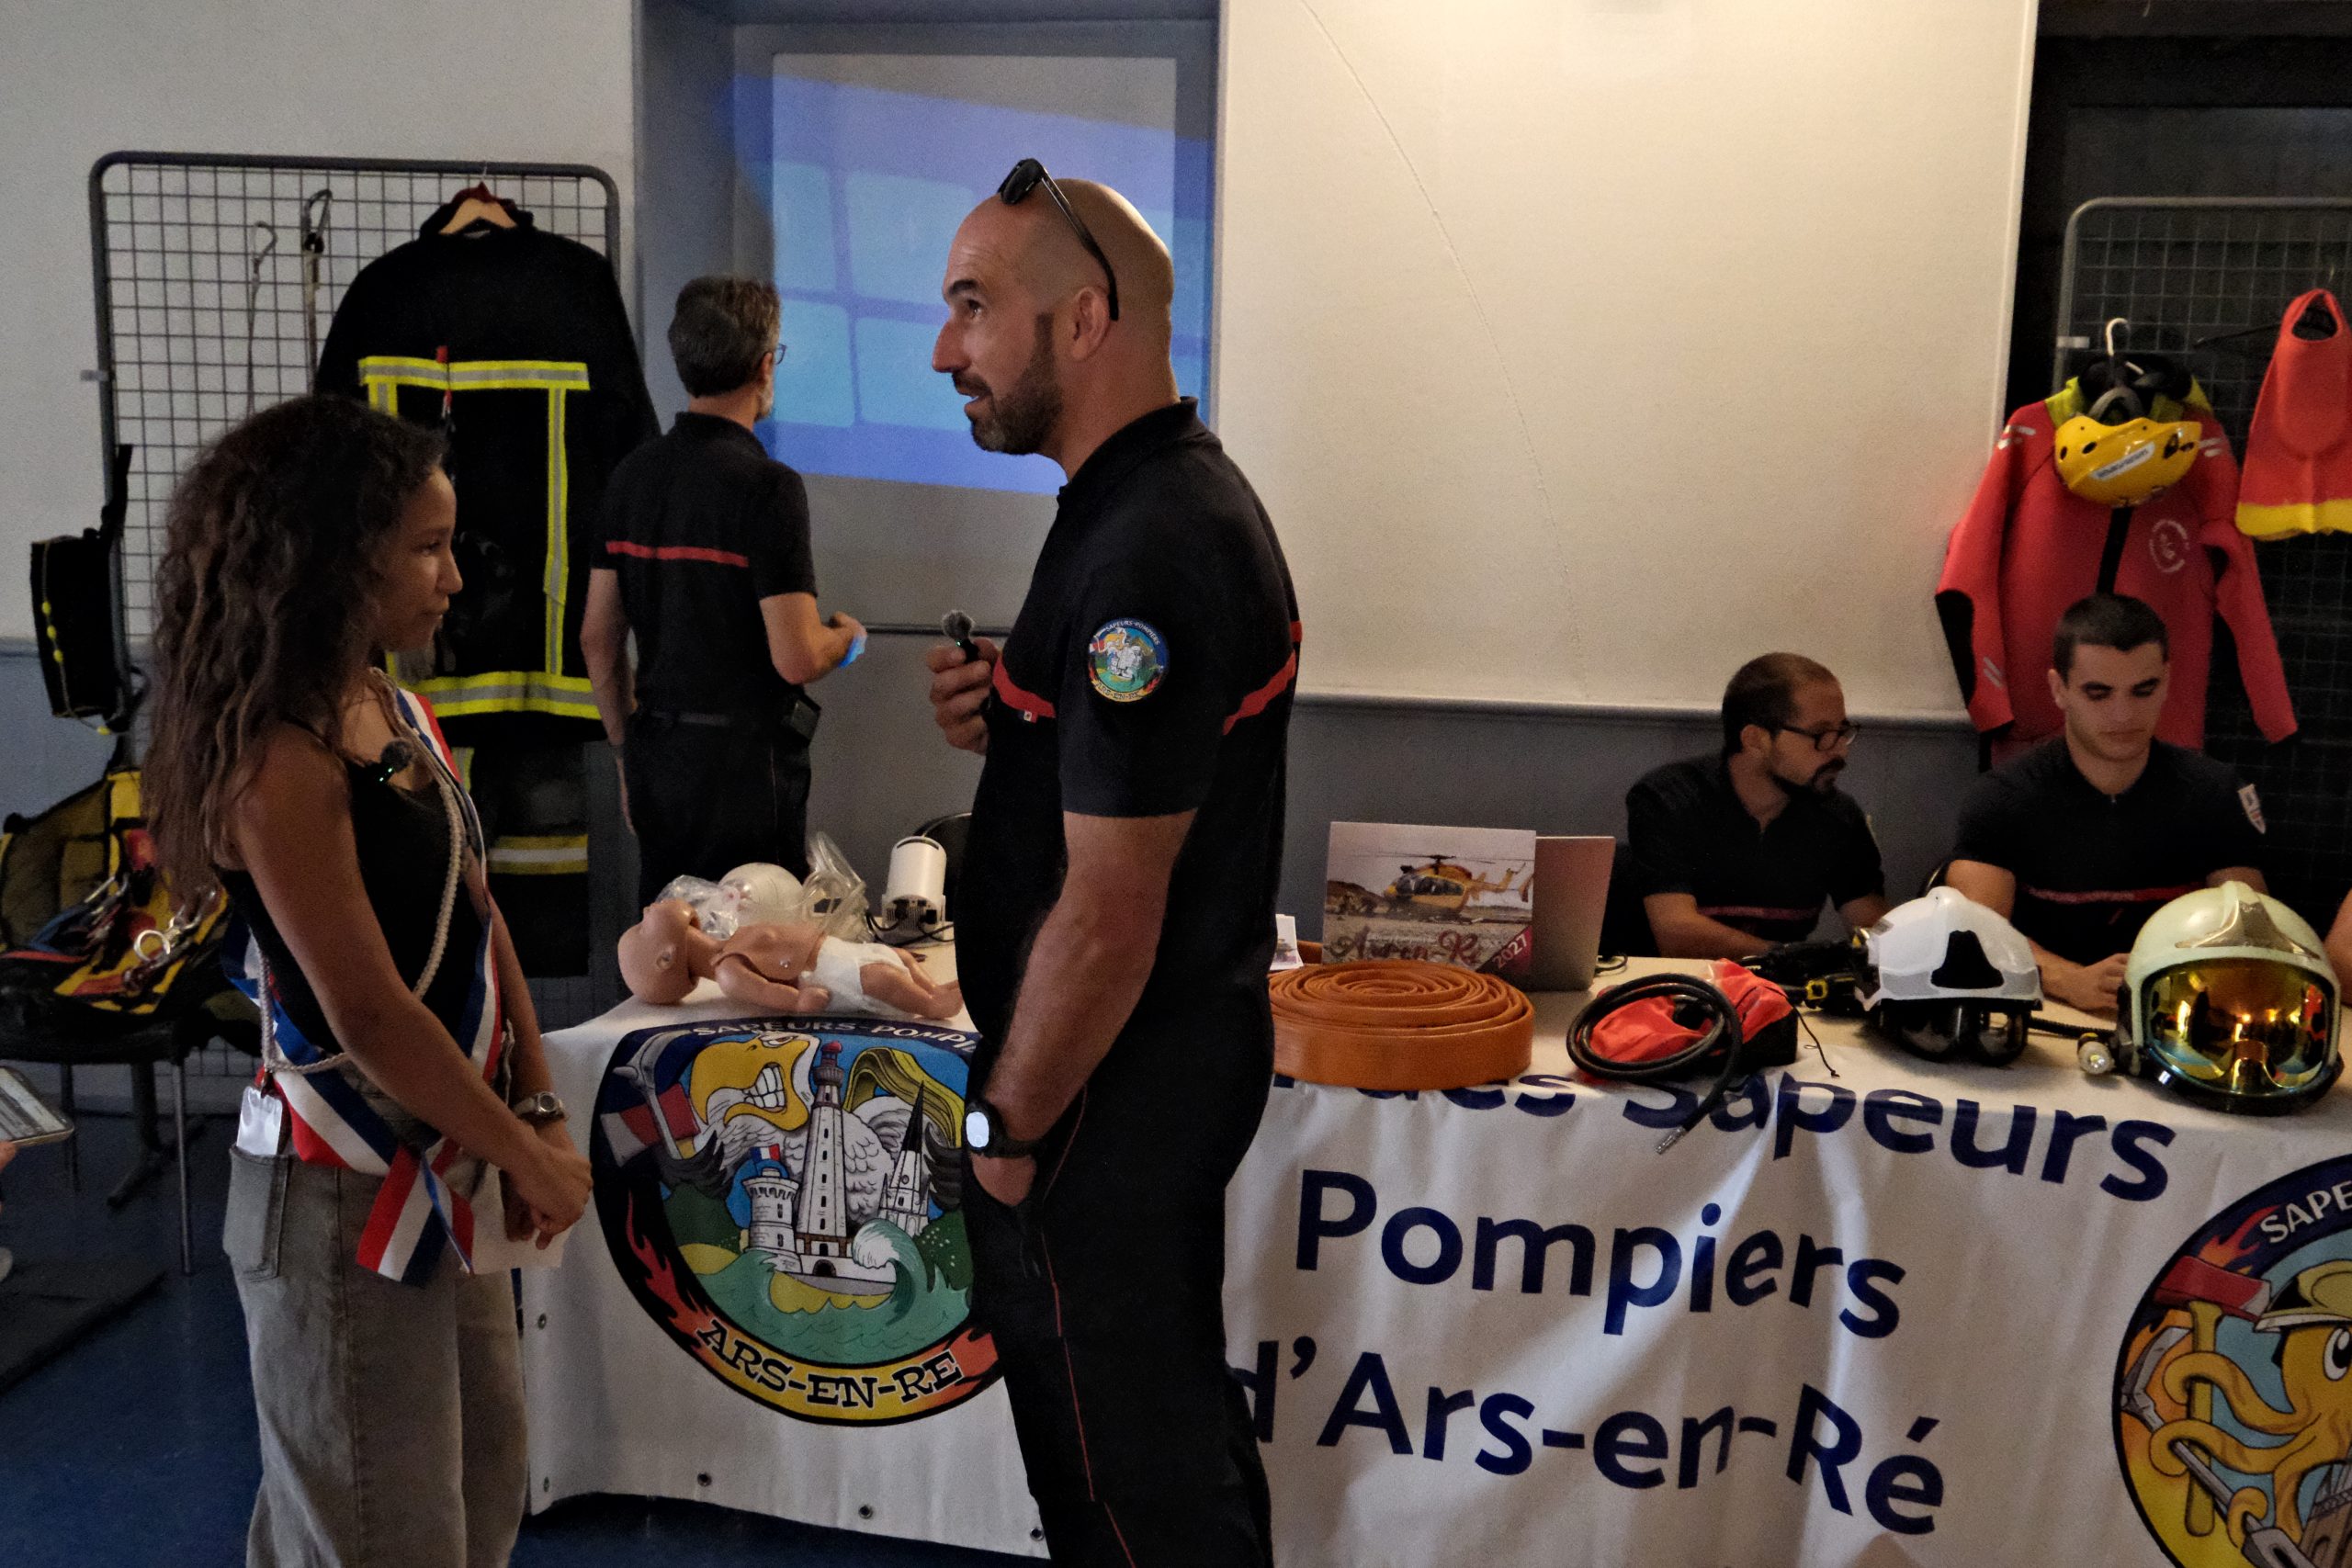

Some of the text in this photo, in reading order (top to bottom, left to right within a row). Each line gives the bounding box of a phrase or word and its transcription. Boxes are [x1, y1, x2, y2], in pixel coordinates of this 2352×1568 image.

[1492, 933, 1527, 969] 2027
[1296, 1169, 1905, 1337] Pompiers
[698, 1319, 964, 1408] ARS-EN-RE
